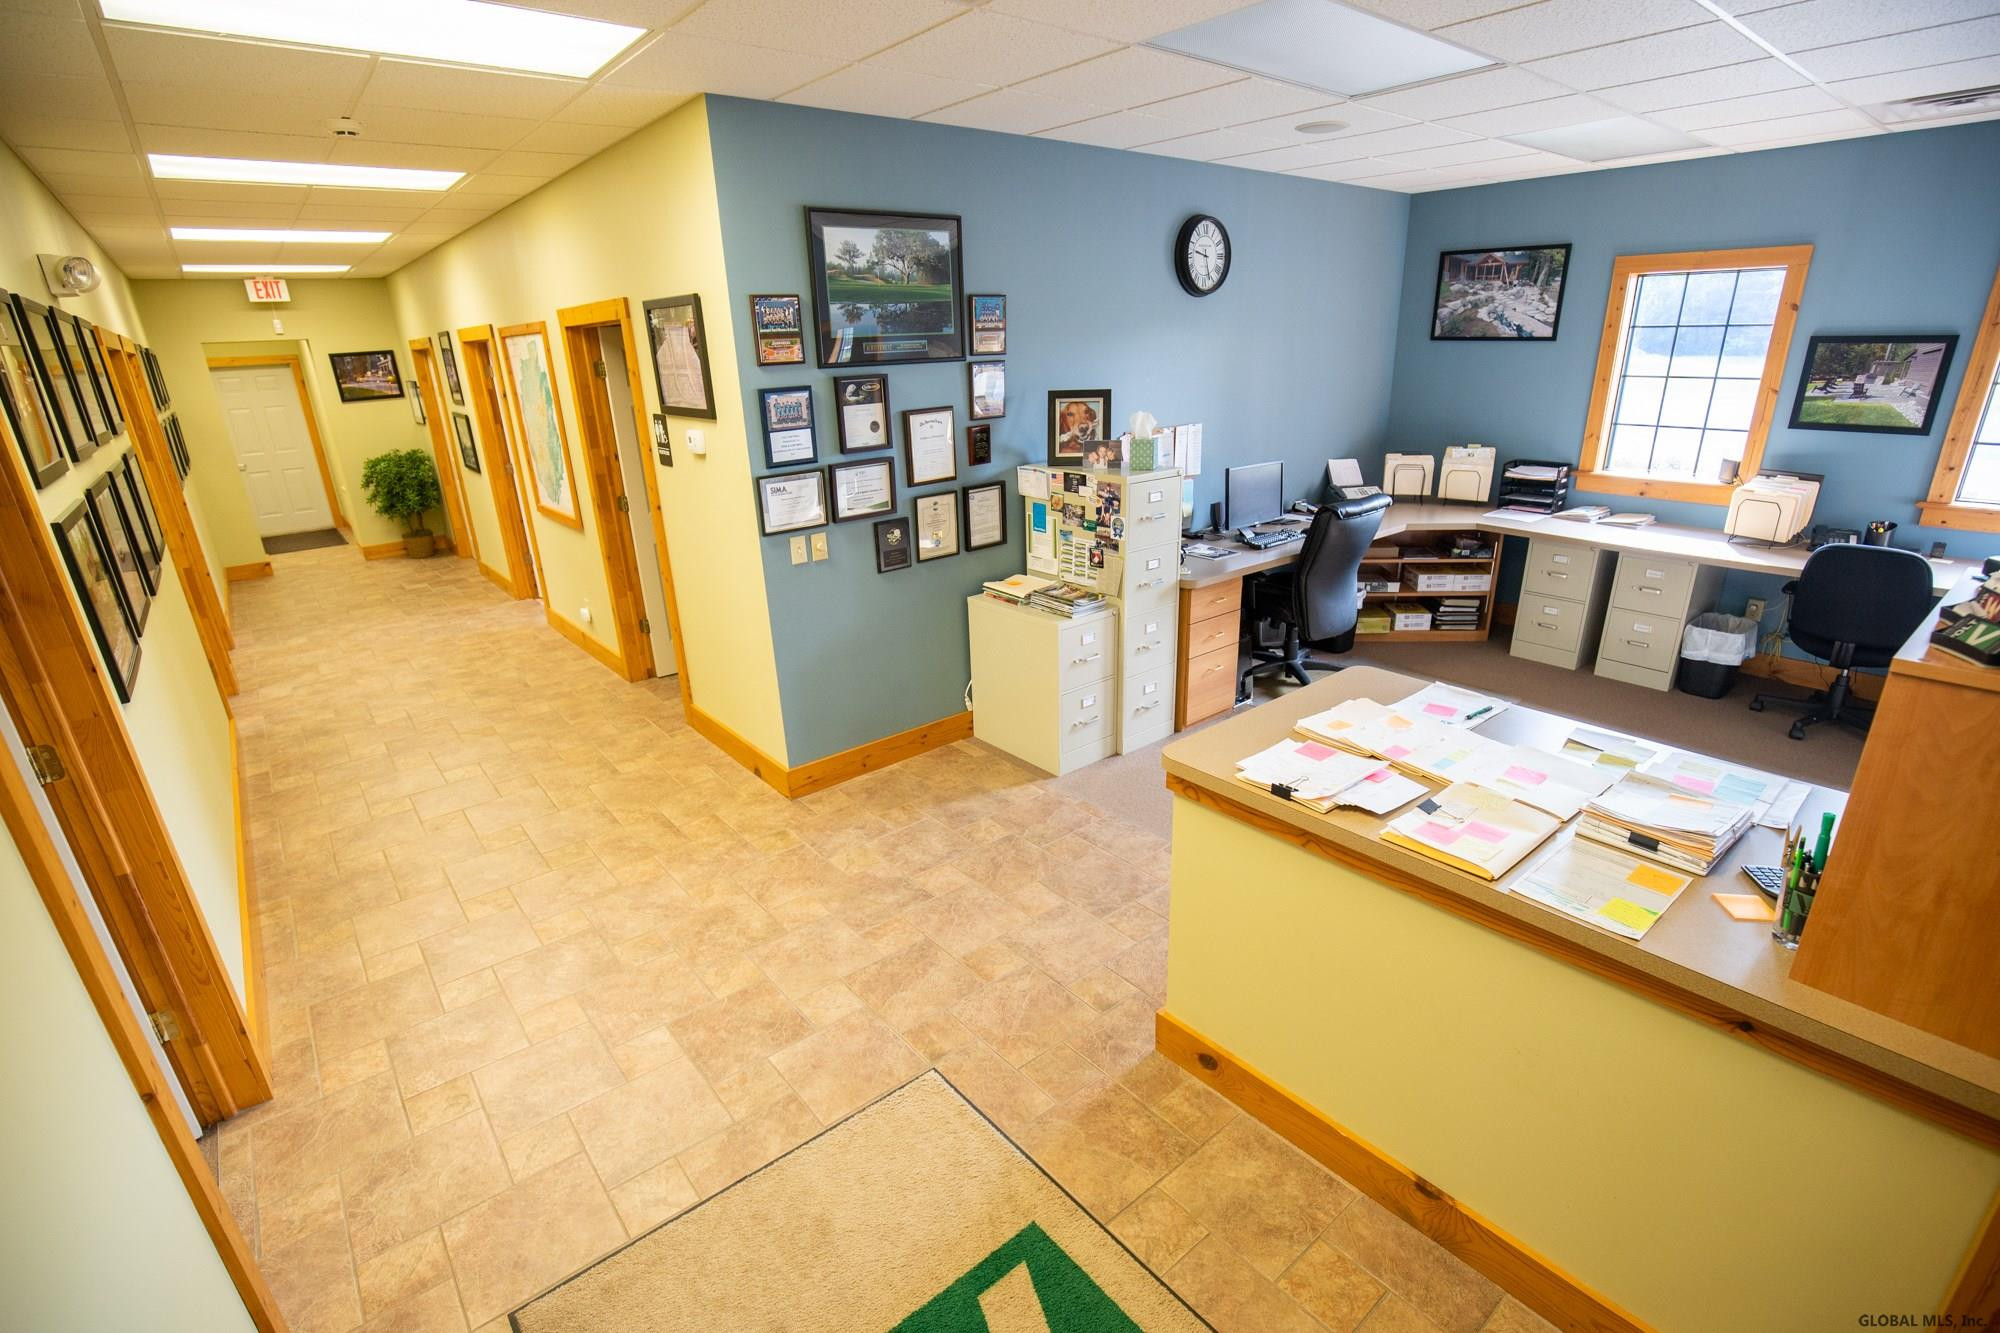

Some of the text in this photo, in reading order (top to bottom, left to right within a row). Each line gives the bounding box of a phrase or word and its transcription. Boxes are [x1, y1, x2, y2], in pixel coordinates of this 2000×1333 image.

[252, 280, 282, 299] EXIT
[769, 485, 788, 494] SIMA
[1949, 618, 1978, 639] OLT
